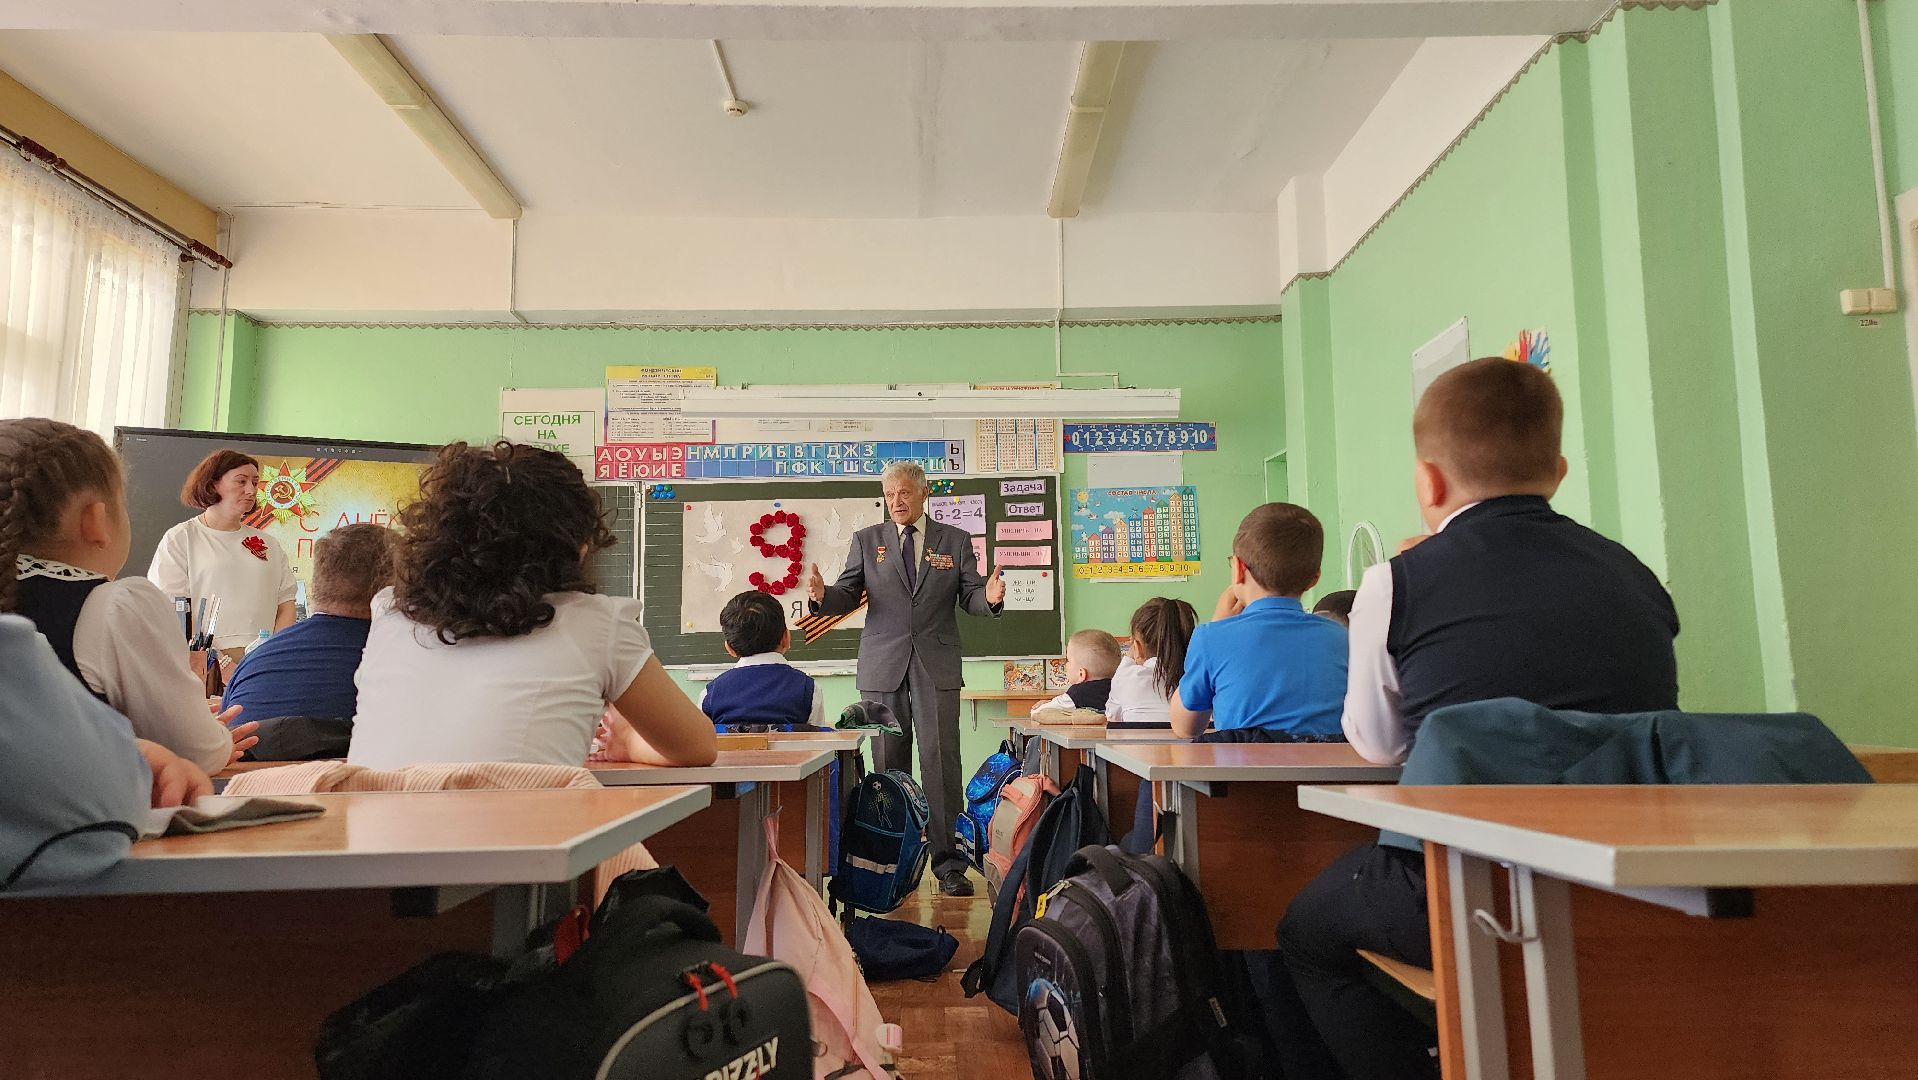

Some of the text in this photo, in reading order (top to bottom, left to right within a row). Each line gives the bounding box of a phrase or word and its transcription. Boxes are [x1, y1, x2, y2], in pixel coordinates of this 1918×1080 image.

[514, 414, 580, 426] СЕГОДНЯ
[538, 430, 557, 440] НА
[1072, 430, 1207, 445] 0 1 2 3 4 5 6 7 8 9 10
[598, 444, 959, 461] А О У Ы Э Н М Л Р Й Б В Г Д Ж З Ь
[600, 465, 610, 478] Я
[619, 462, 627, 477] Ё
[634, 464, 650, 478] Ю
[653, 464, 665, 477] И
[672, 463, 682, 477] Е
[776, 461, 787, 474] П
[792, 460, 806, 473] Ф
[811, 461, 823, 473] К
[830, 461, 840, 473] Т
[843, 461, 859, 472] Ш
[863, 461, 874, 472] С
[949, 459, 959, 470] Ъ
[1004, 483, 1042, 493] Задача
[1008, 505, 1041, 513] Ответ
[300, 511, 320, 532] С
[748, 510, 806, 595] 9
